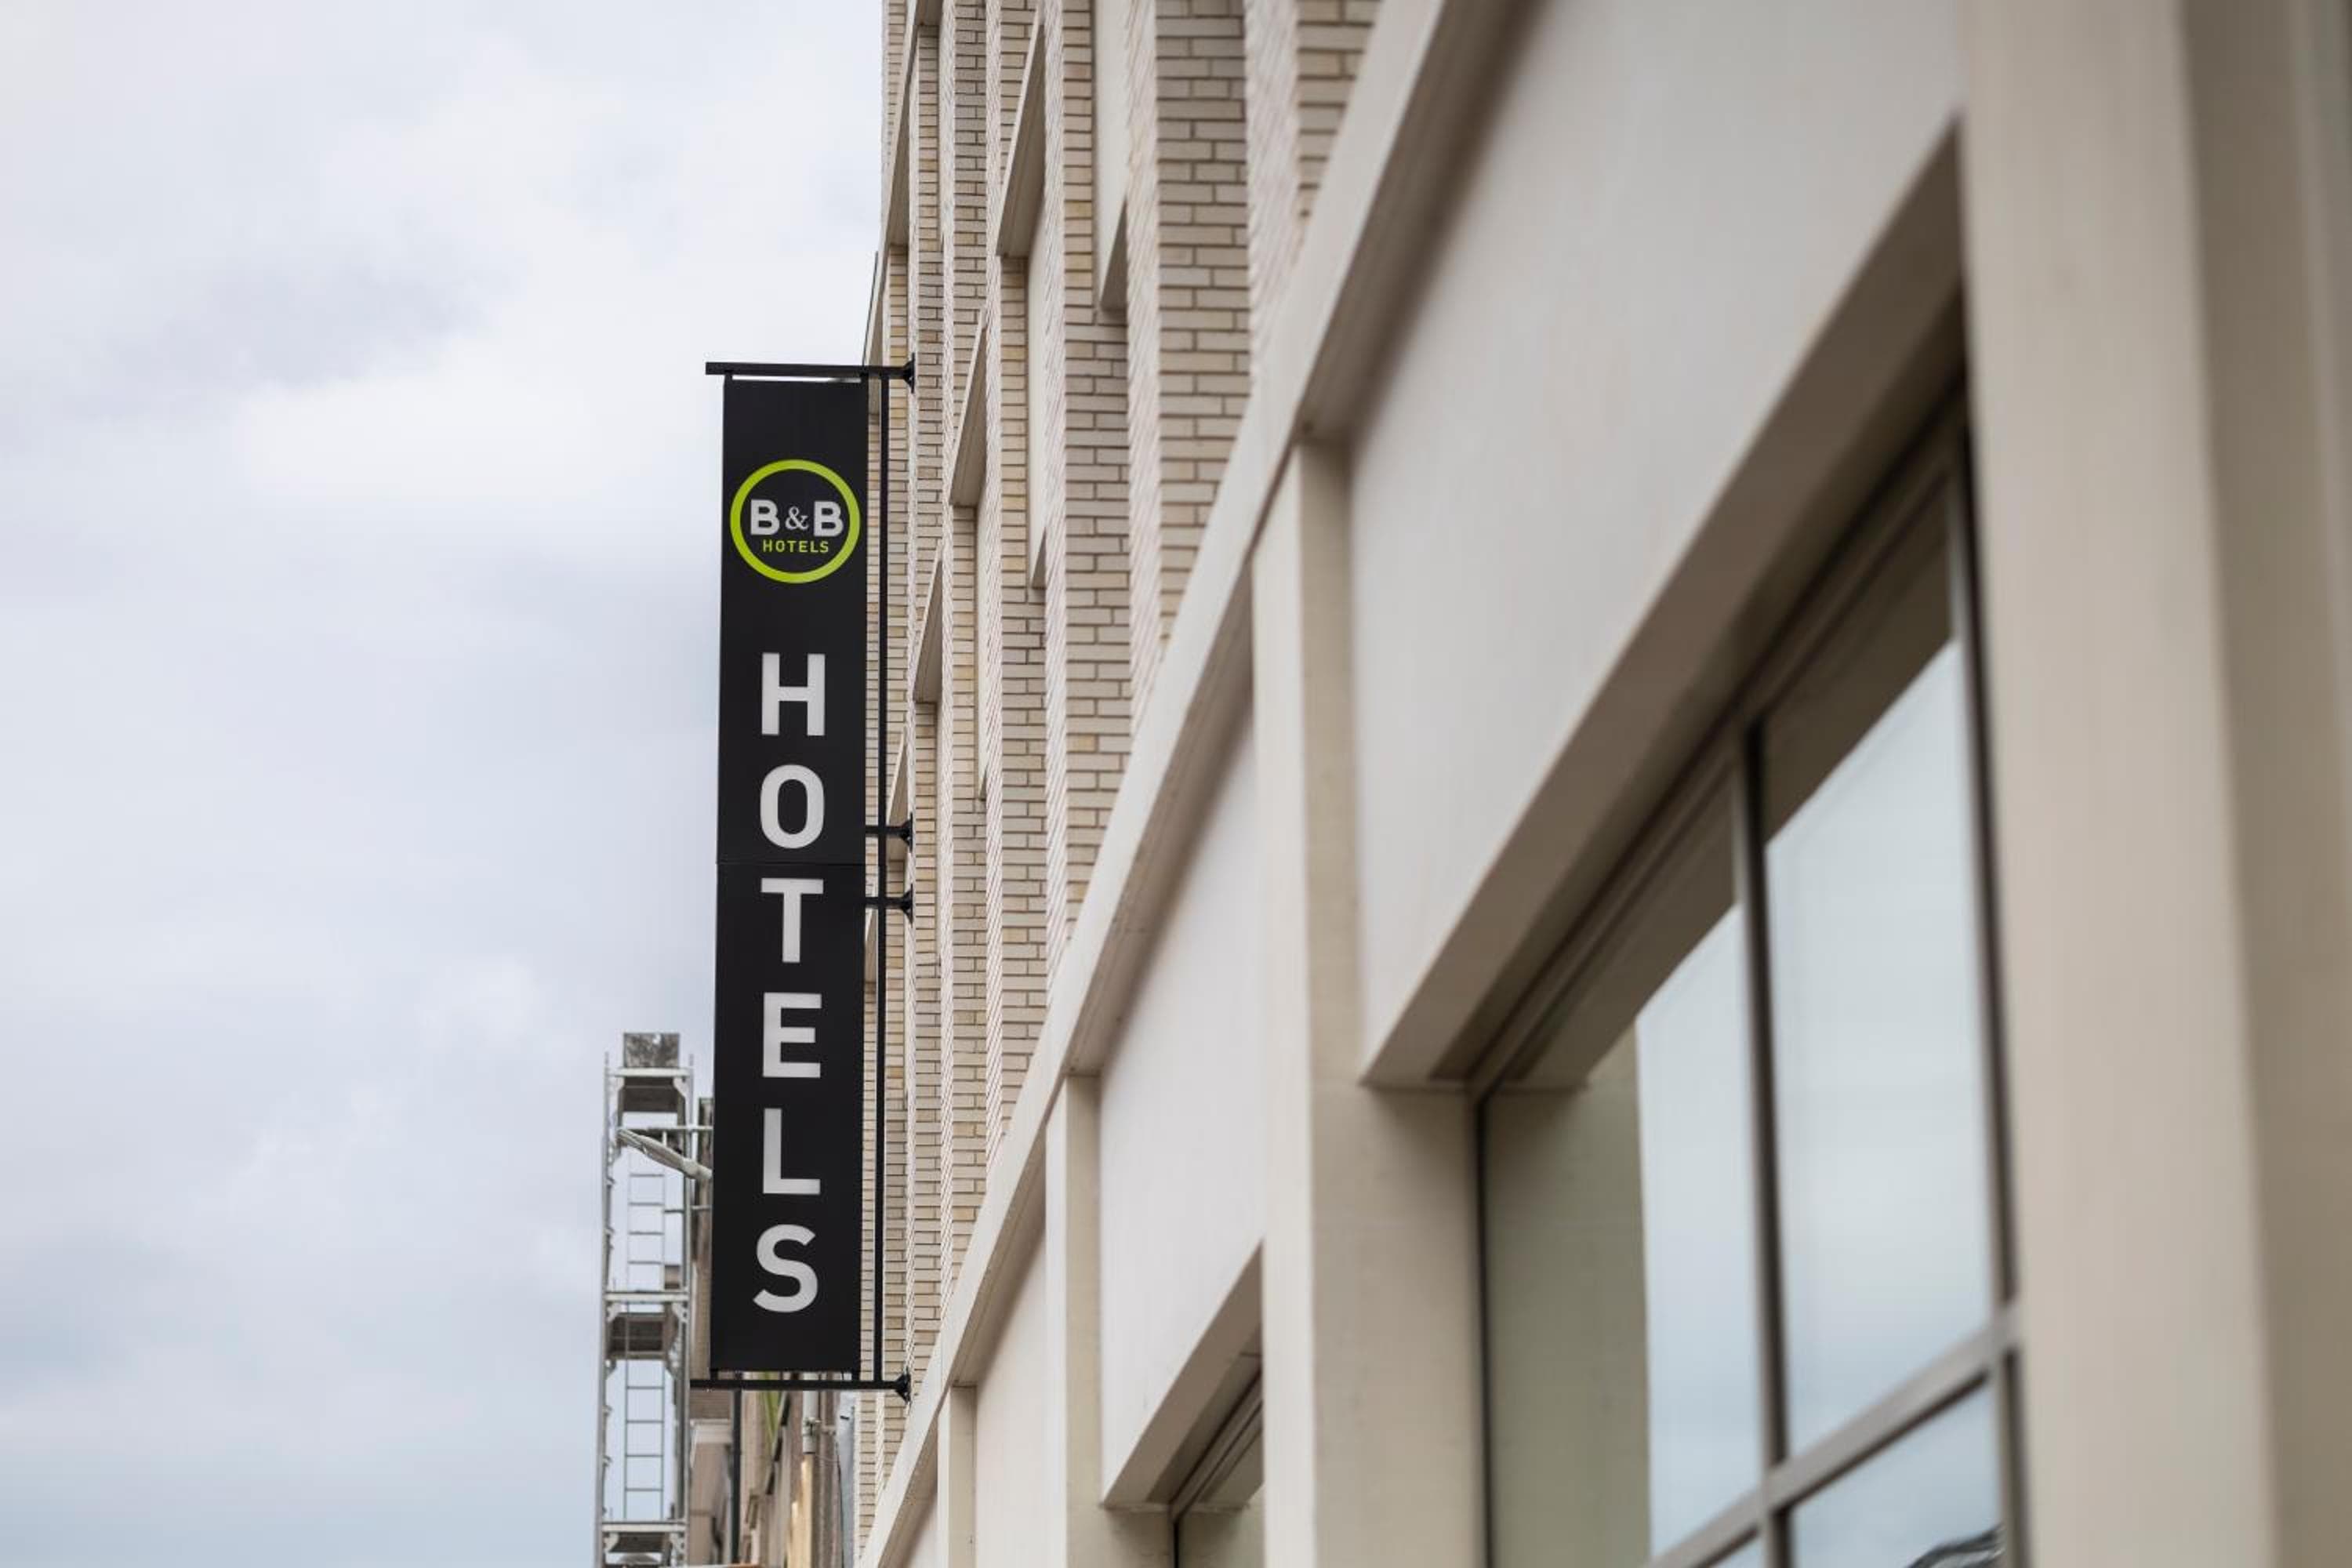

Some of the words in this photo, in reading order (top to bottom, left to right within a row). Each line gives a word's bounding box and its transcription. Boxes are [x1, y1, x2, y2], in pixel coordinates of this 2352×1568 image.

[750, 499, 844, 537] B&B
[762, 539, 829, 554] HOTELS
[753, 653, 826, 1312] HOTELS
